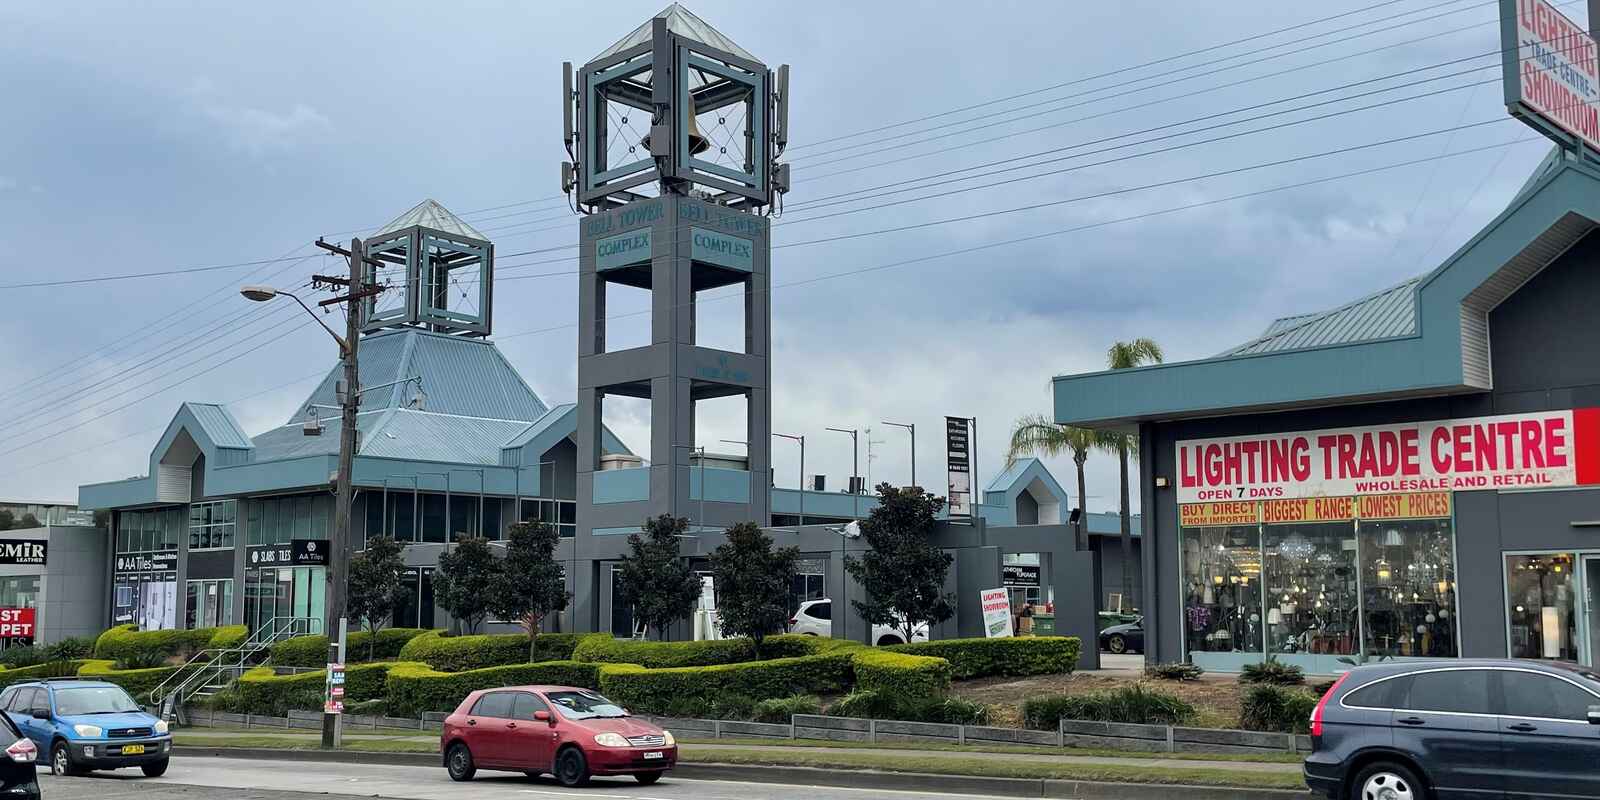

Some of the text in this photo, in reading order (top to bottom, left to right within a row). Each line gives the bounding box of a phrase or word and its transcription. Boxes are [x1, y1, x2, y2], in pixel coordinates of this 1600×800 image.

[1519, 0, 1595, 78] LIGHTING
[1530, 39, 1590, 97] TRADE CENTRE
[1524, 60, 1600, 143] SHOWROOM
[620, 203, 665, 226] TOWER
[598, 233, 649, 257] COMPLEX
[694, 233, 752, 258] COMPLEX
[1180, 418, 1567, 488] LIGHTING TRADE CENTRE
[1198, 486, 1283, 500] OPEN 7 DAYS
[1356, 472, 1552, 492] WHOLESALE AND RETAIL
[1183, 502, 1256, 517] BUY DIRECT
[1264, 497, 1352, 522] BIGGEST RANGE
[1360, 493, 1448, 517] LOWEST PRICES
[1183, 515, 1256, 526] FROM IMPORTER
[124, 557, 136, 570] AA
[136, 556, 152, 570] Tiles
[260, 549, 291, 562] SLABS TILES
[1, 610, 22, 621] ST
[0, 624, 31, 635] PET
